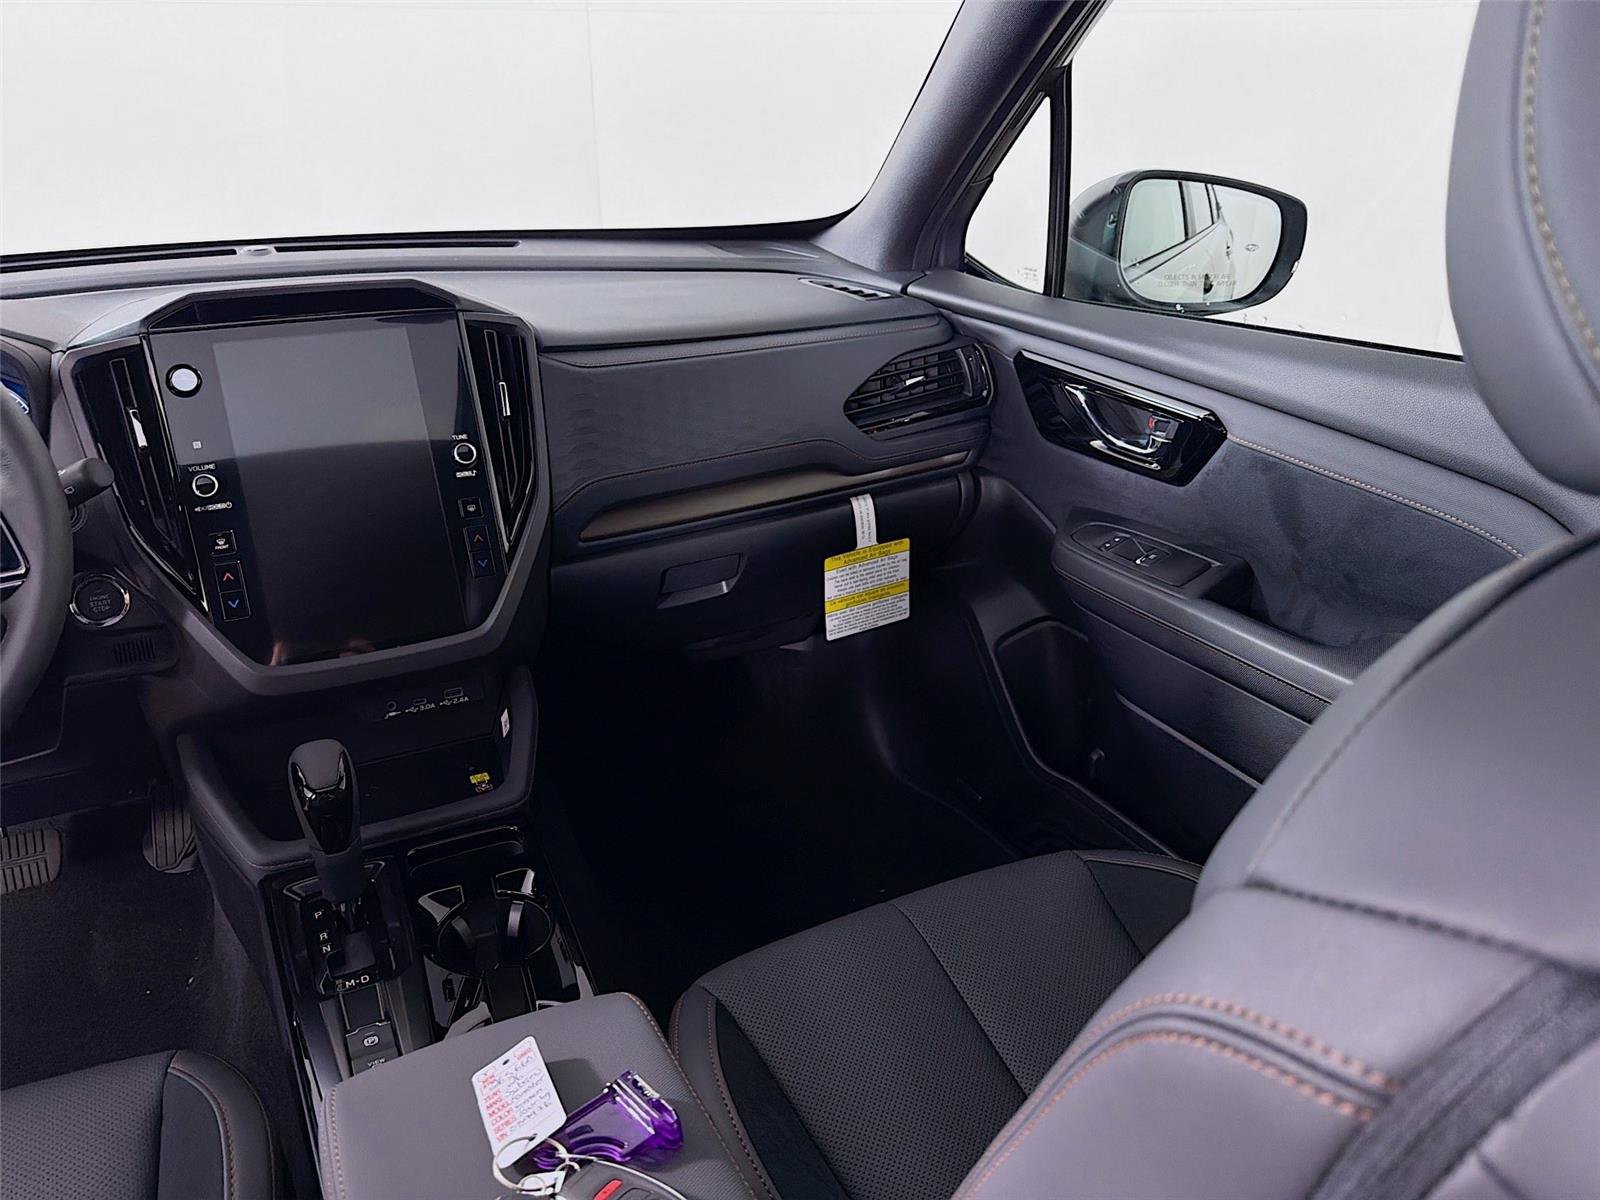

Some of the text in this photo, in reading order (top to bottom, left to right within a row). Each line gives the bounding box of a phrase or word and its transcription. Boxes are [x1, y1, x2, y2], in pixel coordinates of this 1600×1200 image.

[188, 463, 216, 472] VOLUME
[419, 697, 469, 711] 3.0A 2.4A
[314, 910, 323, 920] P
[319, 931, 328, 941] R
[322, 944, 331, 954] N
[367, 1057, 387, 1067] VIEW
